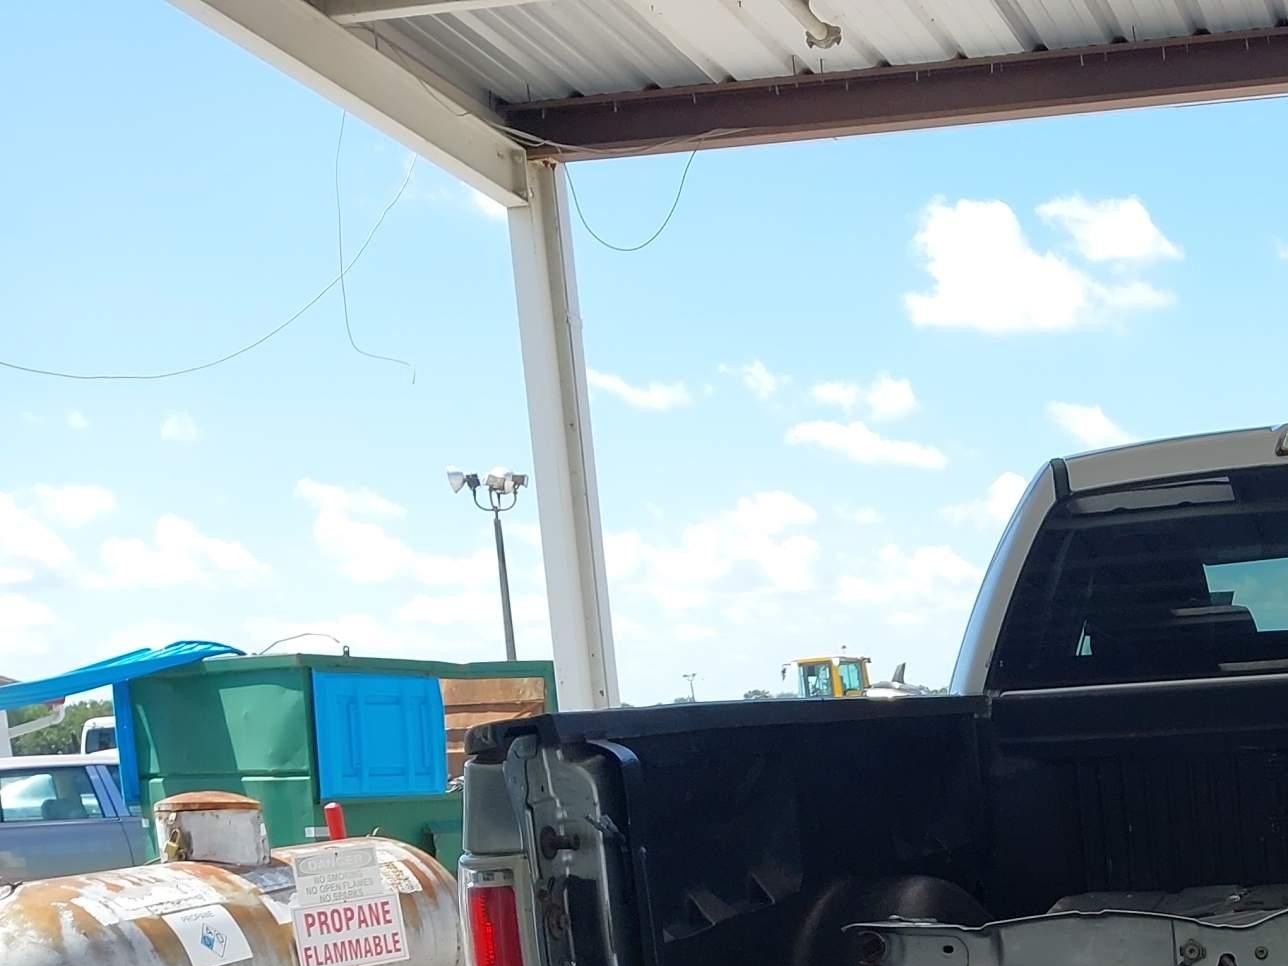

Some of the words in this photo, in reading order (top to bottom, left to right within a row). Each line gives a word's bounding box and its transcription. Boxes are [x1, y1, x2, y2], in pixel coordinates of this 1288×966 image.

[308, 855, 363, 869] DANGER
[314, 875, 325, 884] NO
[306, 887, 317, 896] NO
[320, 883, 340, 894] OPEN
[343, 878, 374, 890] FLAMES
[320, 894, 331, 904] NO
[333, 890, 364, 902] SPARKS
[304, 901, 393, 937] PROPANE
